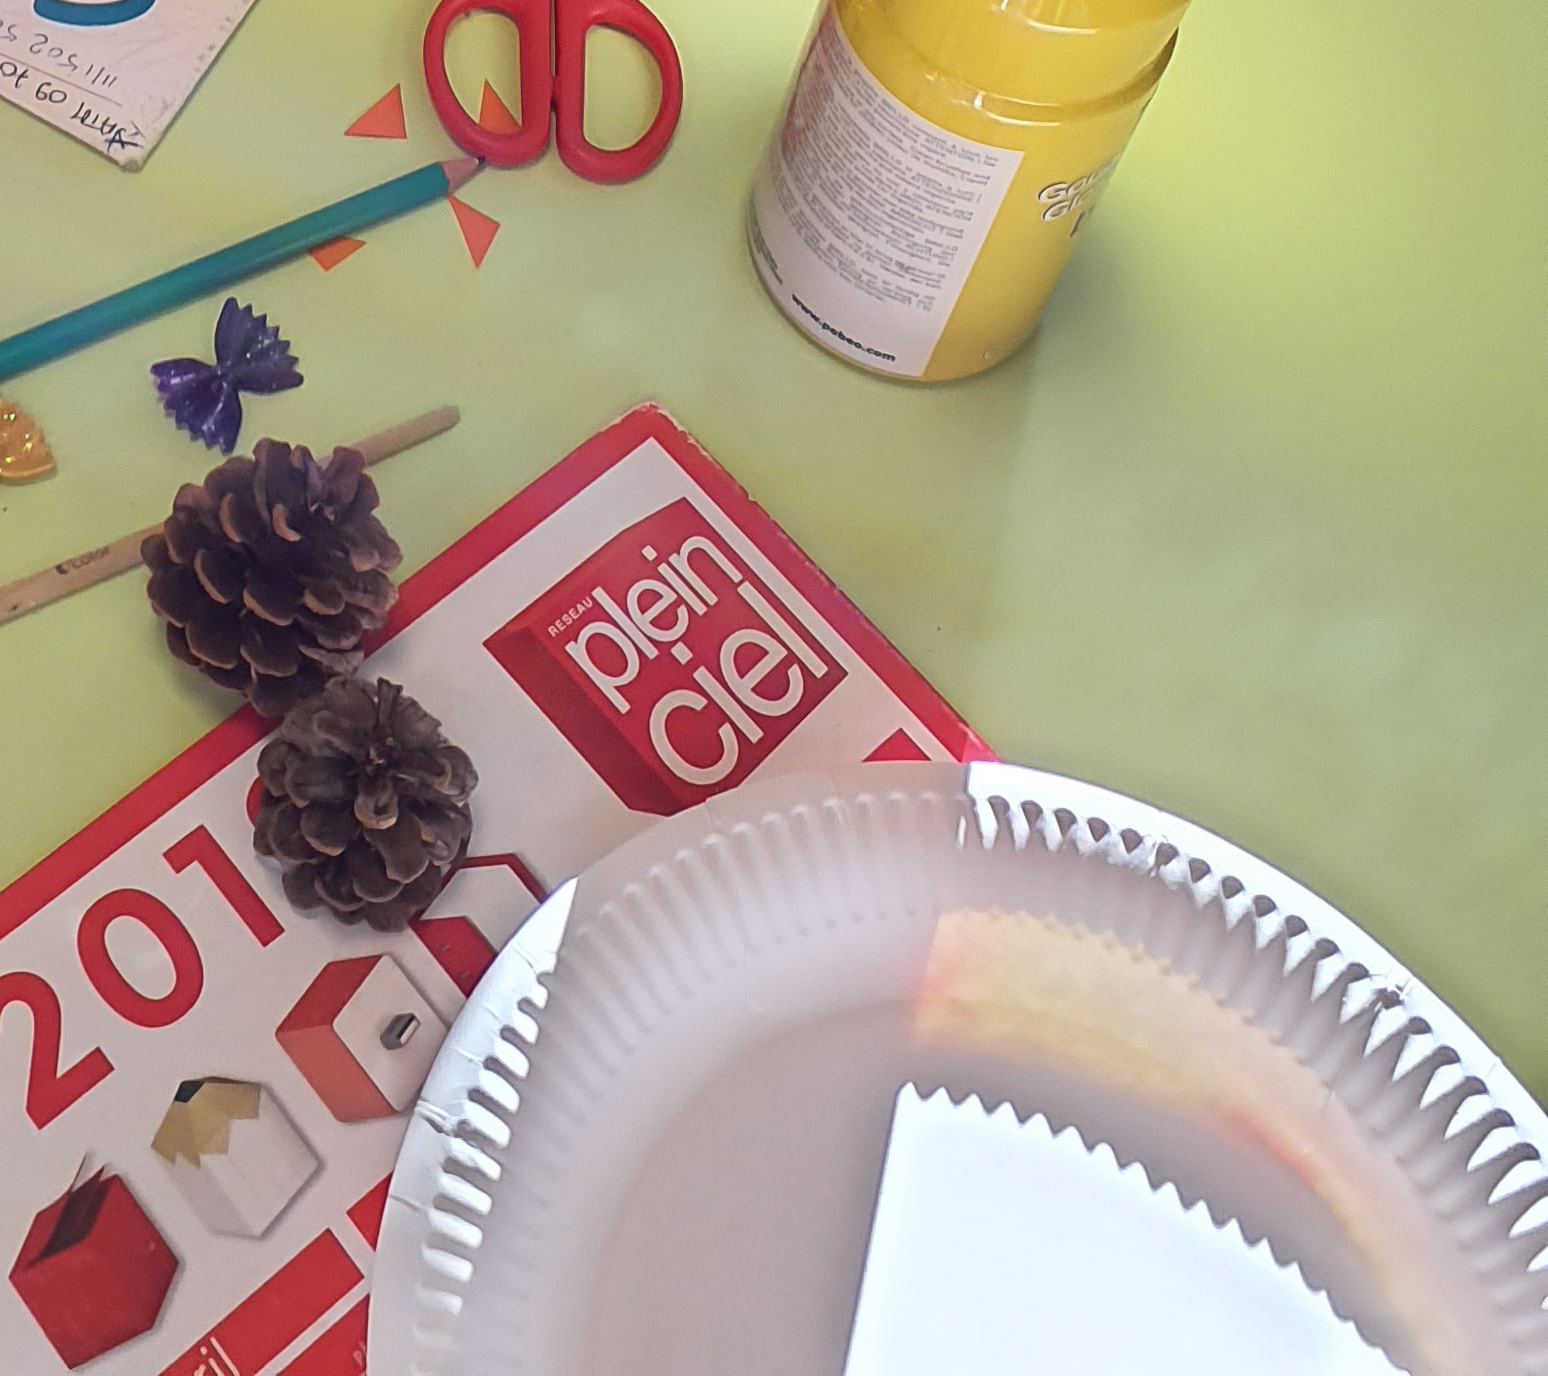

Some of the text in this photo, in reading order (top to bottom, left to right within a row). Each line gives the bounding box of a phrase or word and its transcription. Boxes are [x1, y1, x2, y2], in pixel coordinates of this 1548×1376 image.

[791, 294, 896, 362] www.pebeo.com
[547, 597, 594, 637] RESEAU
[566, 535, 743, 714] plein
[649, 580, 827, 785] ciel
